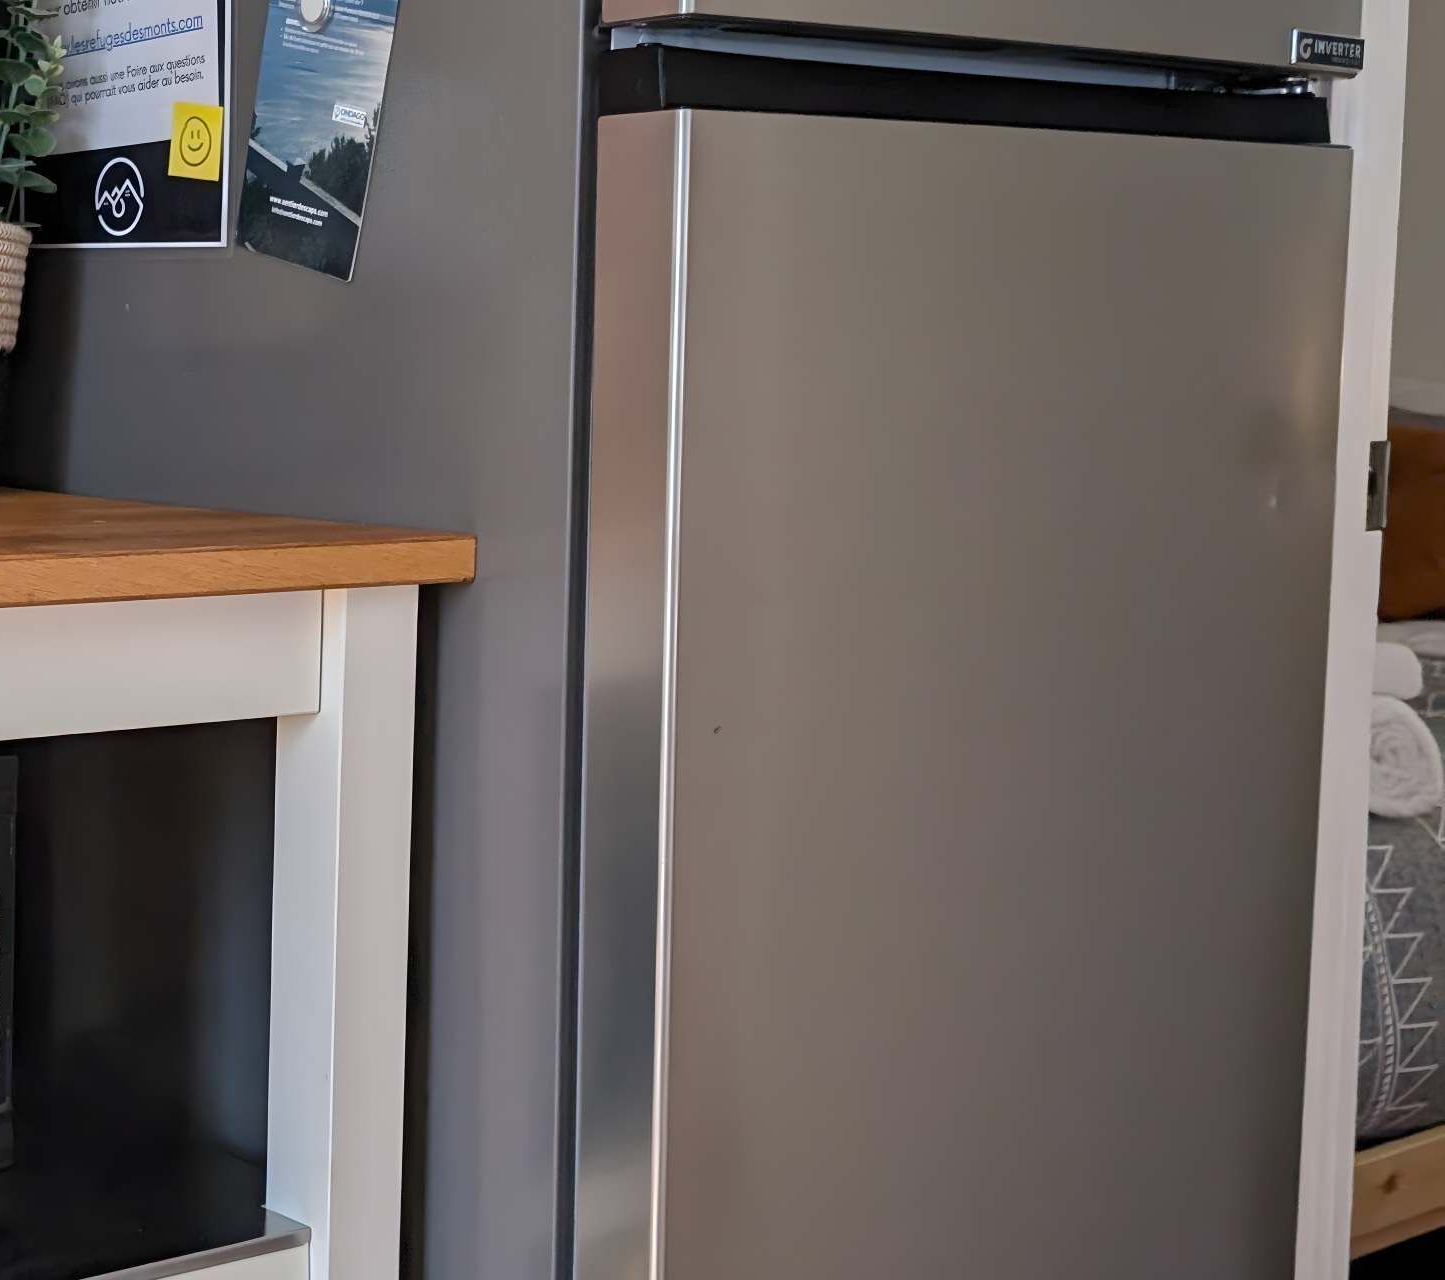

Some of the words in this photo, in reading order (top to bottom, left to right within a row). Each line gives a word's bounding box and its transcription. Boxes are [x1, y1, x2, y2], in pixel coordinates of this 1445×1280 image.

[1314, 39, 1361, 59] INVERTER
[90, 70, 108, 84] aussi
[127, 64, 148, 80] Foire
[149, 62, 165, 75] aux
[166, 54, 206, 75] questions
[85, 86, 117, 104] pourrait
[118, 82, 136, 96] vous
[138, 74, 161, 92] aider
[161, 75, 173, 88] au
